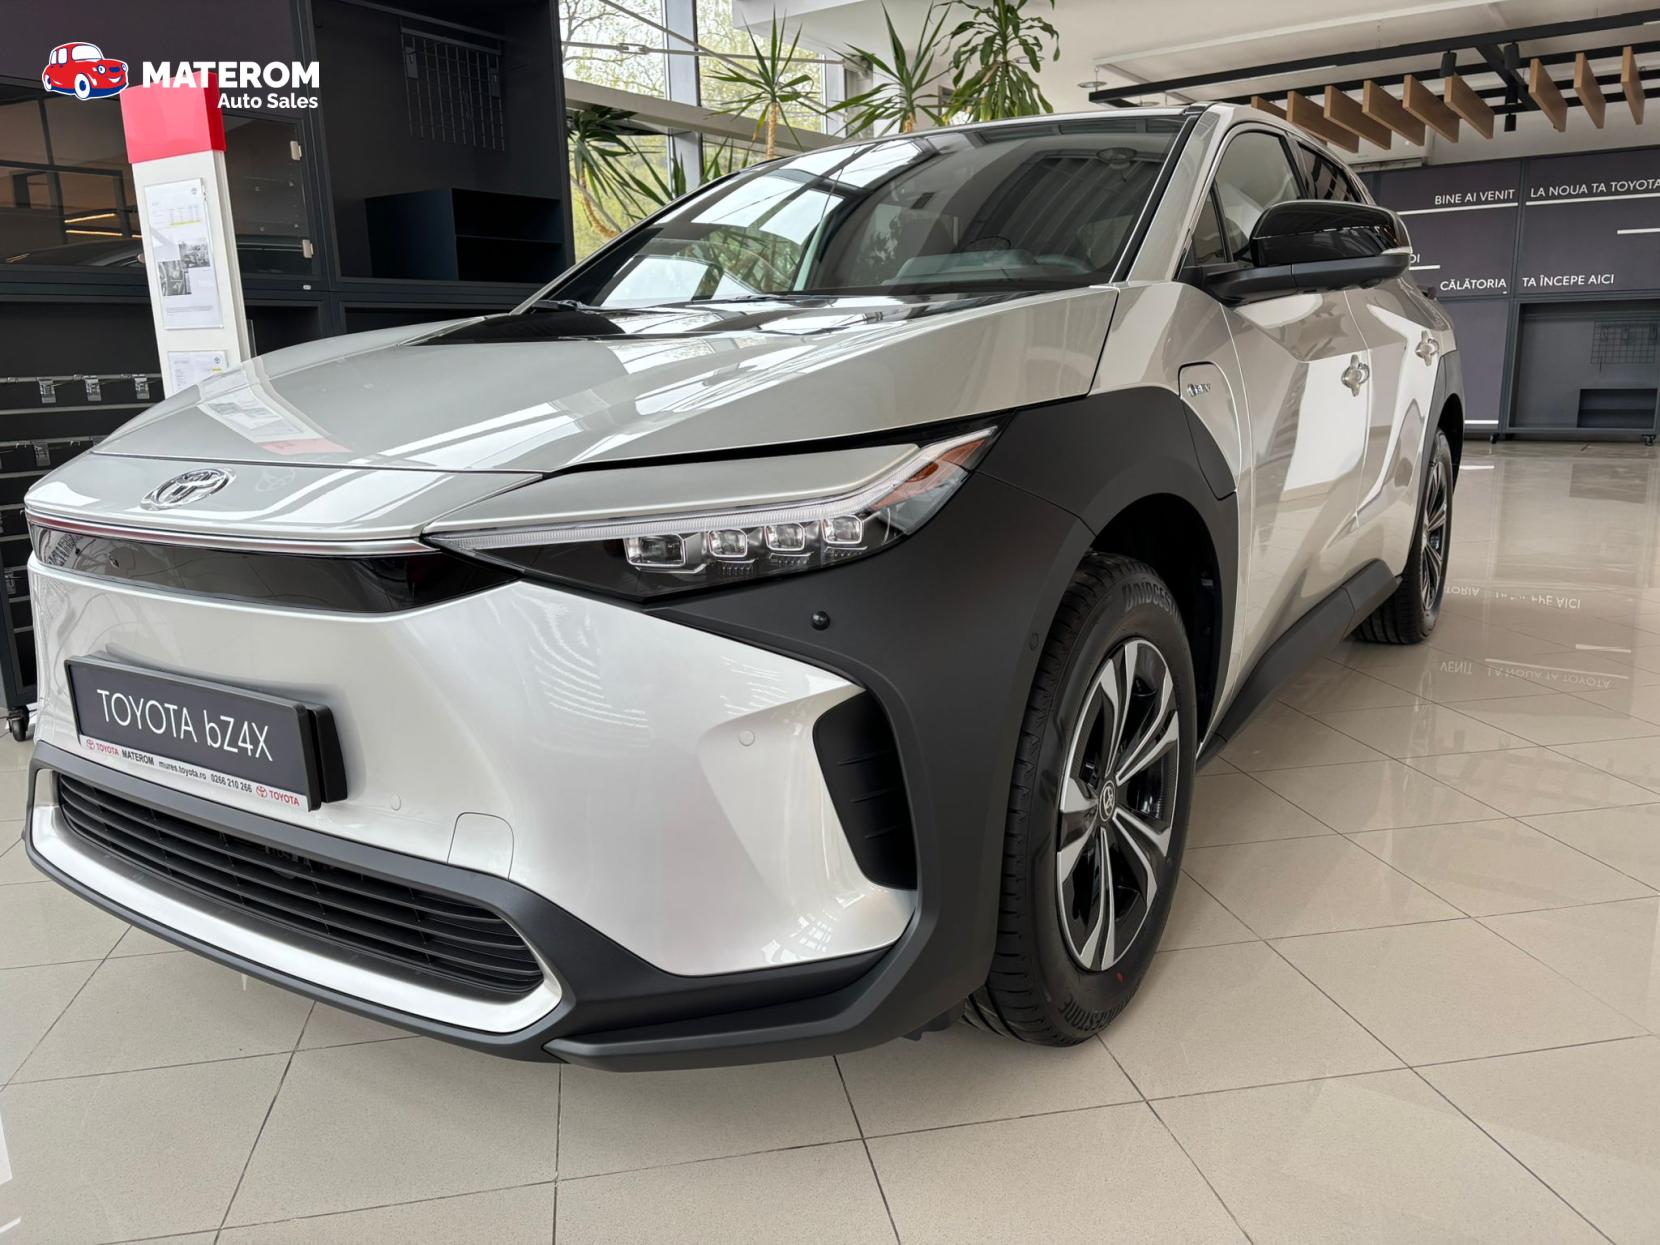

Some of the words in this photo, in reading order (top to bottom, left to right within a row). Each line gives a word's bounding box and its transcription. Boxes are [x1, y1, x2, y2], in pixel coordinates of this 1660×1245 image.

[1434, 193, 1462, 205] BINE
[1464, 192, 1477, 203] AI
[1480, 189, 1516, 201] VENIT
[1530, 187, 1546, 198] LA
[1549, 184, 1588, 197] NOUA
[1592, 182, 1607, 193] TA
[1611, 179, 1660, 192] TOYOTA
[1440, 278, 1507, 291] CĂLĂTORIA
[1522, 277, 1537, 287] TA
[1540, 274, 1586, 287] ÎNCEPE
[1588, 274, 1615, 285] AICI
[97, 689, 197, 743] TOYOTA
[203, 709, 272, 762] bZ4X
[96, 743, 119, 756] TOYOTA
[121, 749, 155, 766] MATEROM
[269, 790, 300, 806] TOYOTA
